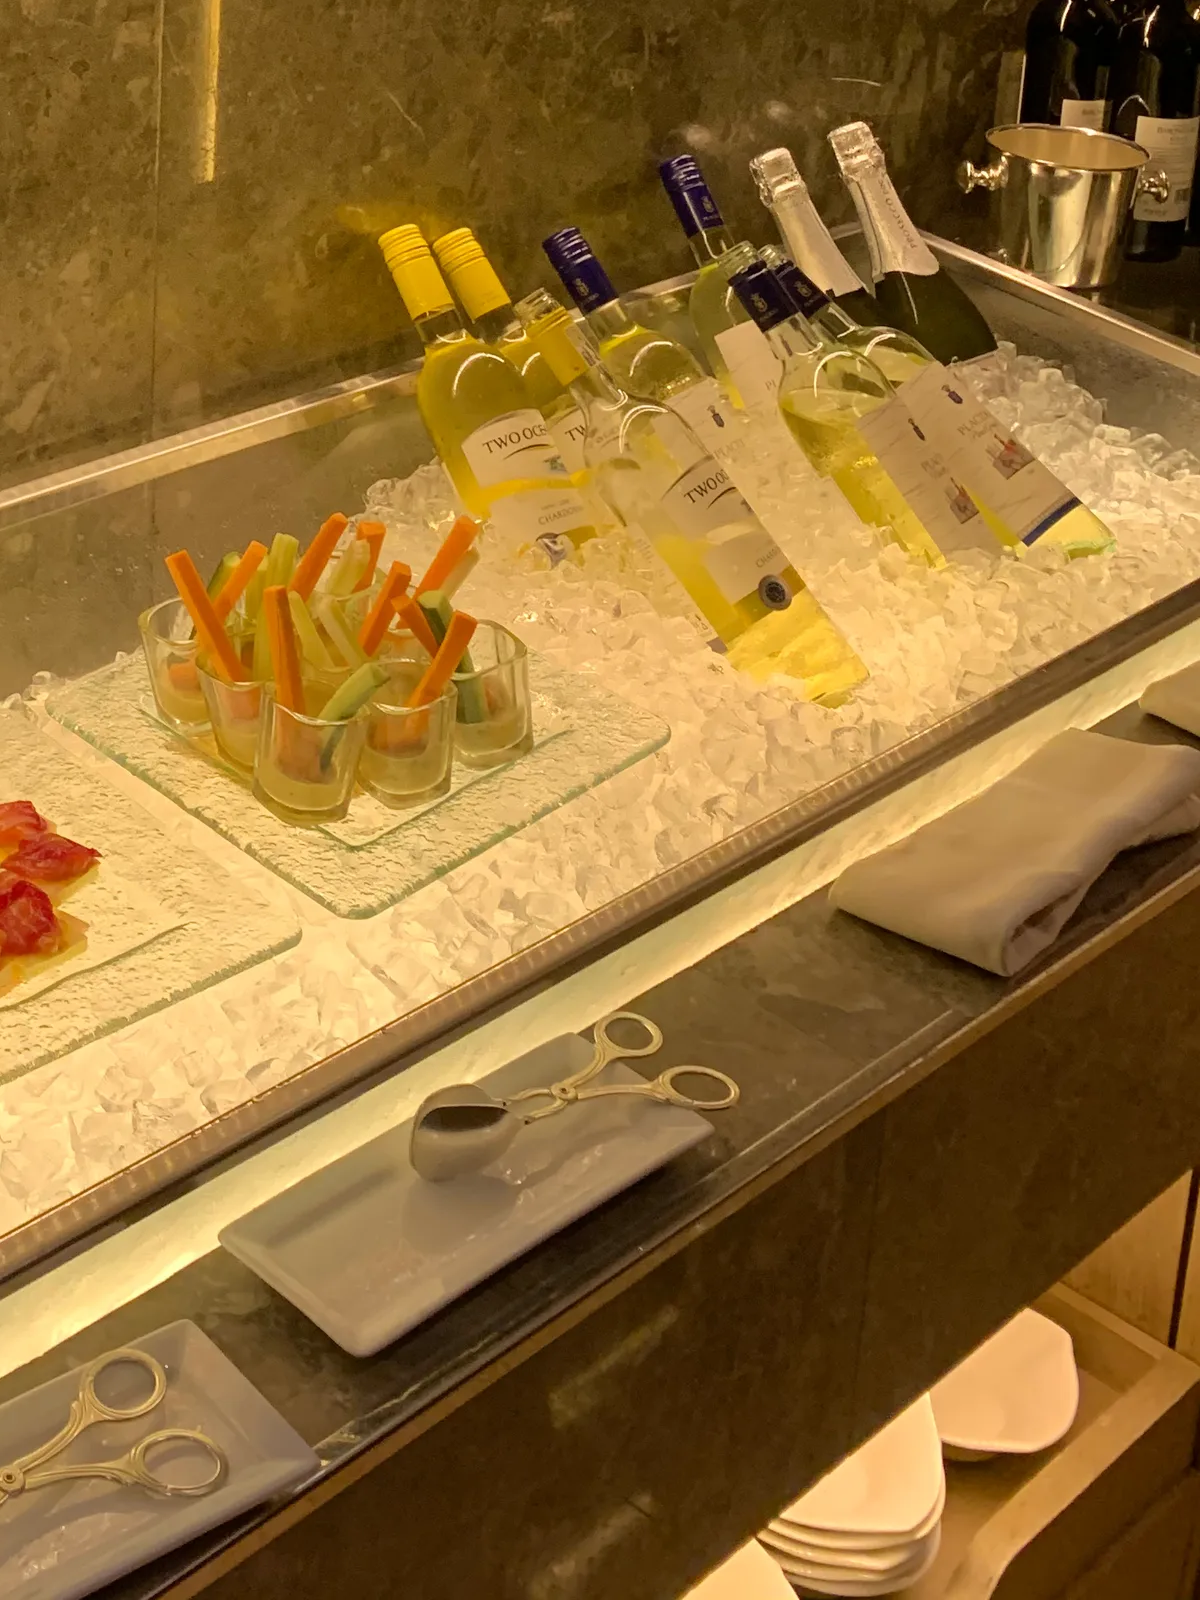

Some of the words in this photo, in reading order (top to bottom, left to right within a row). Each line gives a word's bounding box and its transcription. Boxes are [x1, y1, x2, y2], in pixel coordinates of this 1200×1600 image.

[482, 431, 521, 454] TWO
[565, 424, 587, 442] TW
[684, 476, 718, 504] TWO
